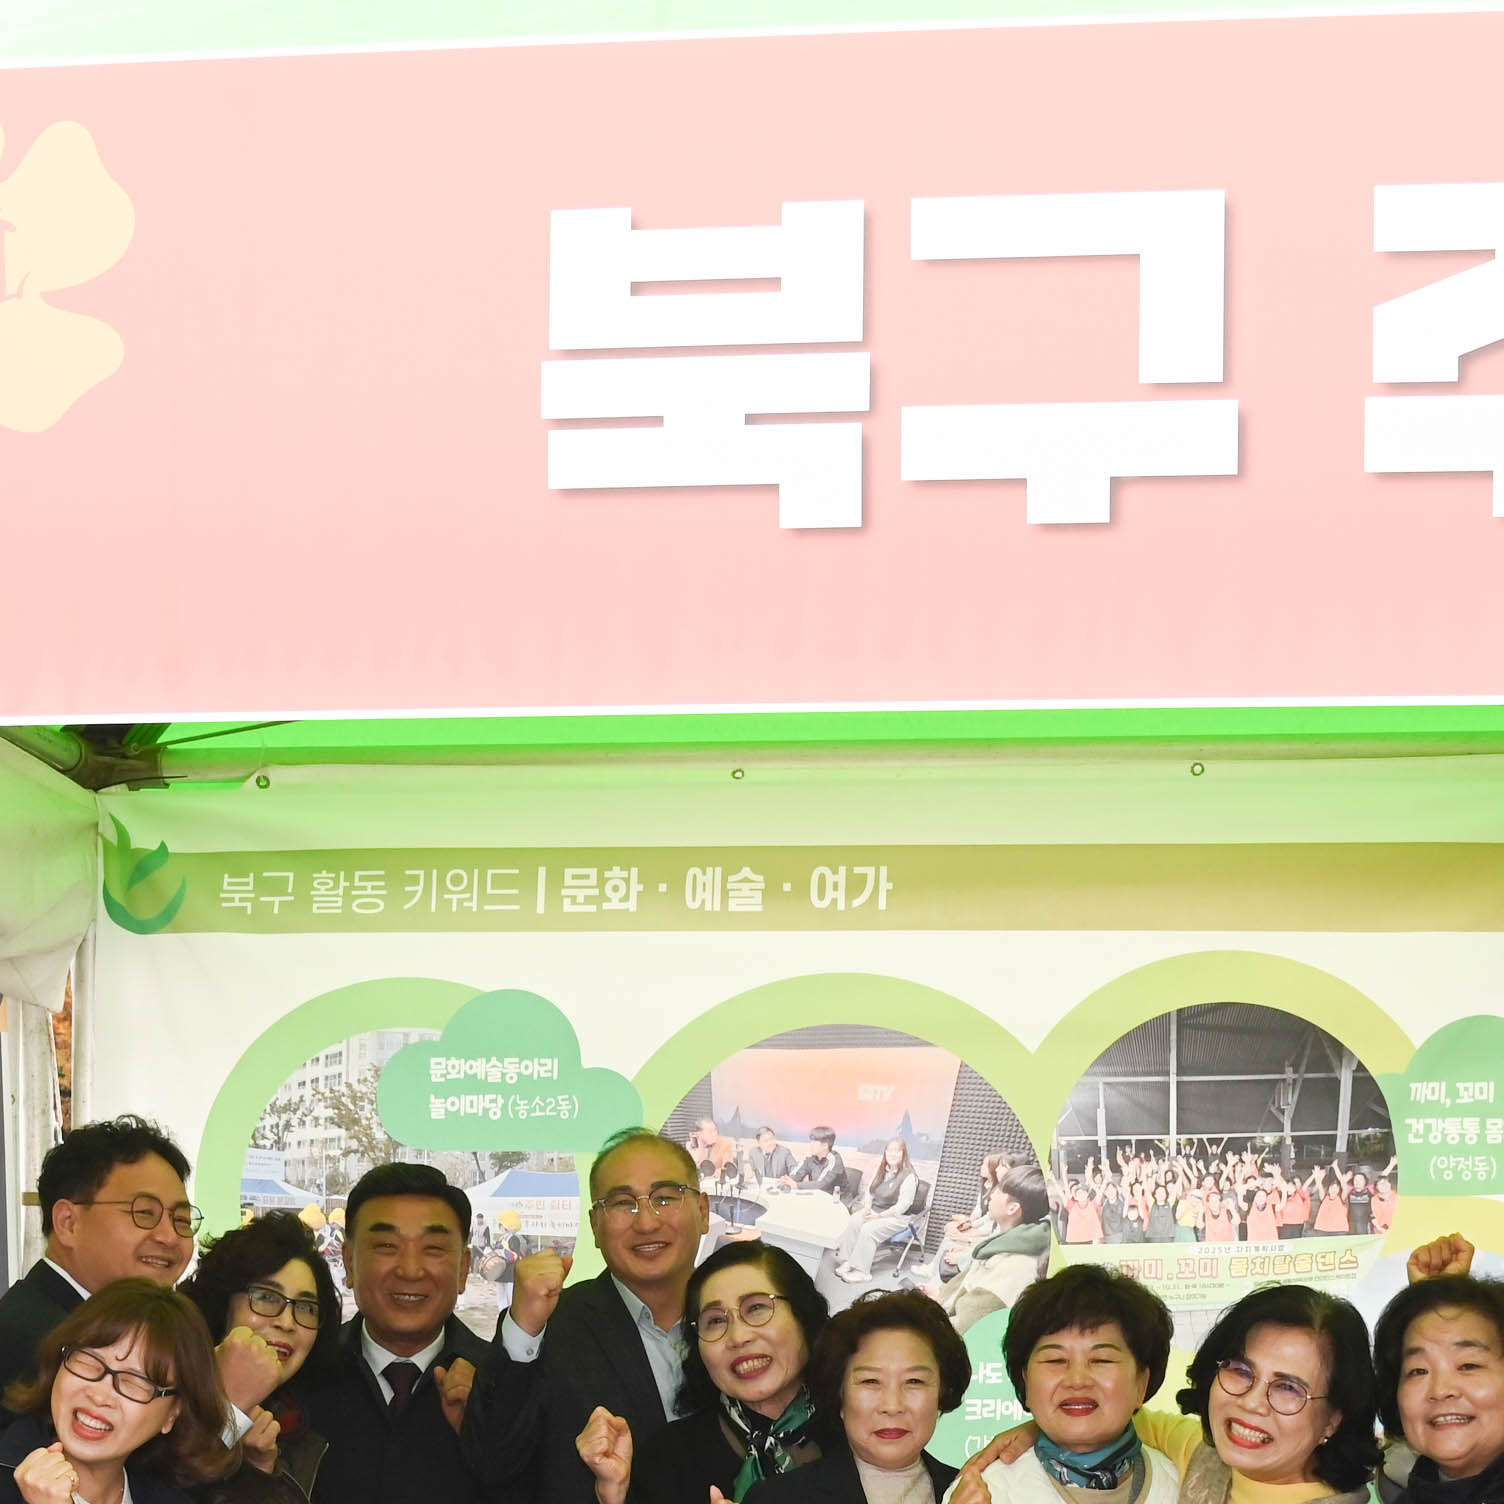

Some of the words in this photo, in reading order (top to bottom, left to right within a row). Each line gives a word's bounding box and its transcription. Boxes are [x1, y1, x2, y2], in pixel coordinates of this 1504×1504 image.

[539, 188, 1241, 530] 북구
[218, 872, 295, 915] 북구
[308, 869, 388, 914] 활동
[403, 868, 522, 913] 키워드
[561, 865, 643, 914] 문화
[684, 865, 765, 912] 예술
[808, 864, 893, 912] 여가
[428, 1056, 559, 1082] 문화예술동아리
[428, 1093, 503, 1120] 놀이마당
[507, 1094, 579, 1120] (농소2동)
[1409, 1080, 1452, 1106] 까미,
[1456, 1080, 1495, 1104] 꼬미
[1405, 1116, 1479, 1144] 건강통통
[1429, 1153, 1497, 1181] (양정동)
